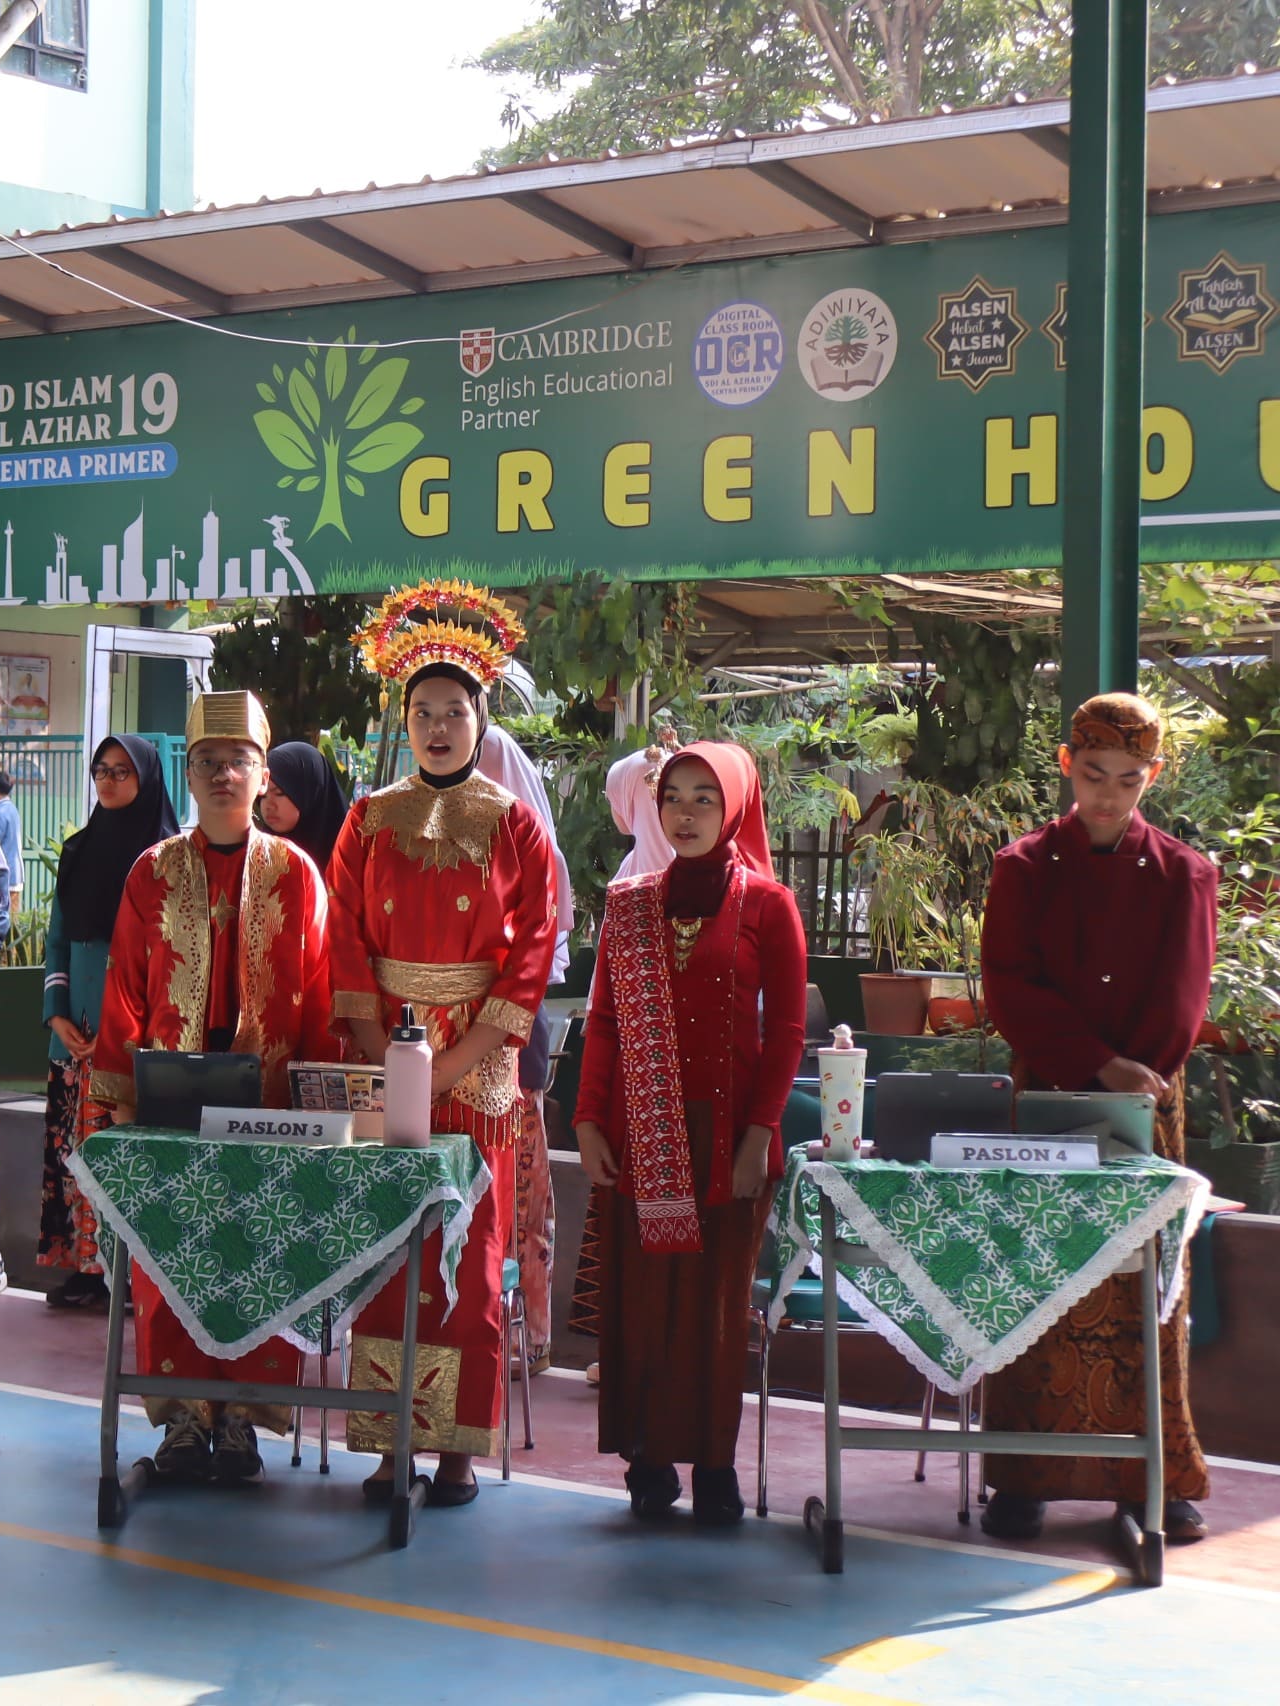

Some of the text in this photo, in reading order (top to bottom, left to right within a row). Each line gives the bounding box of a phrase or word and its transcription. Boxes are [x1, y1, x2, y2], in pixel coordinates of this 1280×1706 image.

[717, 309, 761, 321] DIGITAL
[948, 300, 1007, 319] ALSEN
[704, 320, 774, 335] CLASS ROOM
[805, 298, 890, 352] ADIWIYATA
[950, 318, 985, 335] Hebat
[497, 320, 673, 361] CAMBRIDGE
[948, 333, 1006, 352] ALSEN
[1194, 332, 1244, 350] ALSEN
[697, 332, 781, 376] DCR
[966, 352, 1004, 366] Juara
[461, 361, 673, 407] English Educational
[23, 375, 113, 411] ISLAM
[117, 372, 179, 437] 19
[20, 413, 112, 446] AZHAR
[461, 408, 541, 432] Partner
[79, 449, 167, 477] PRIMER
[399, 425, 877, 538] GREEN
[227, 1120, 324, 1137] PASLON 3
[962, 1147, 1067, 1161] PASLON 4
